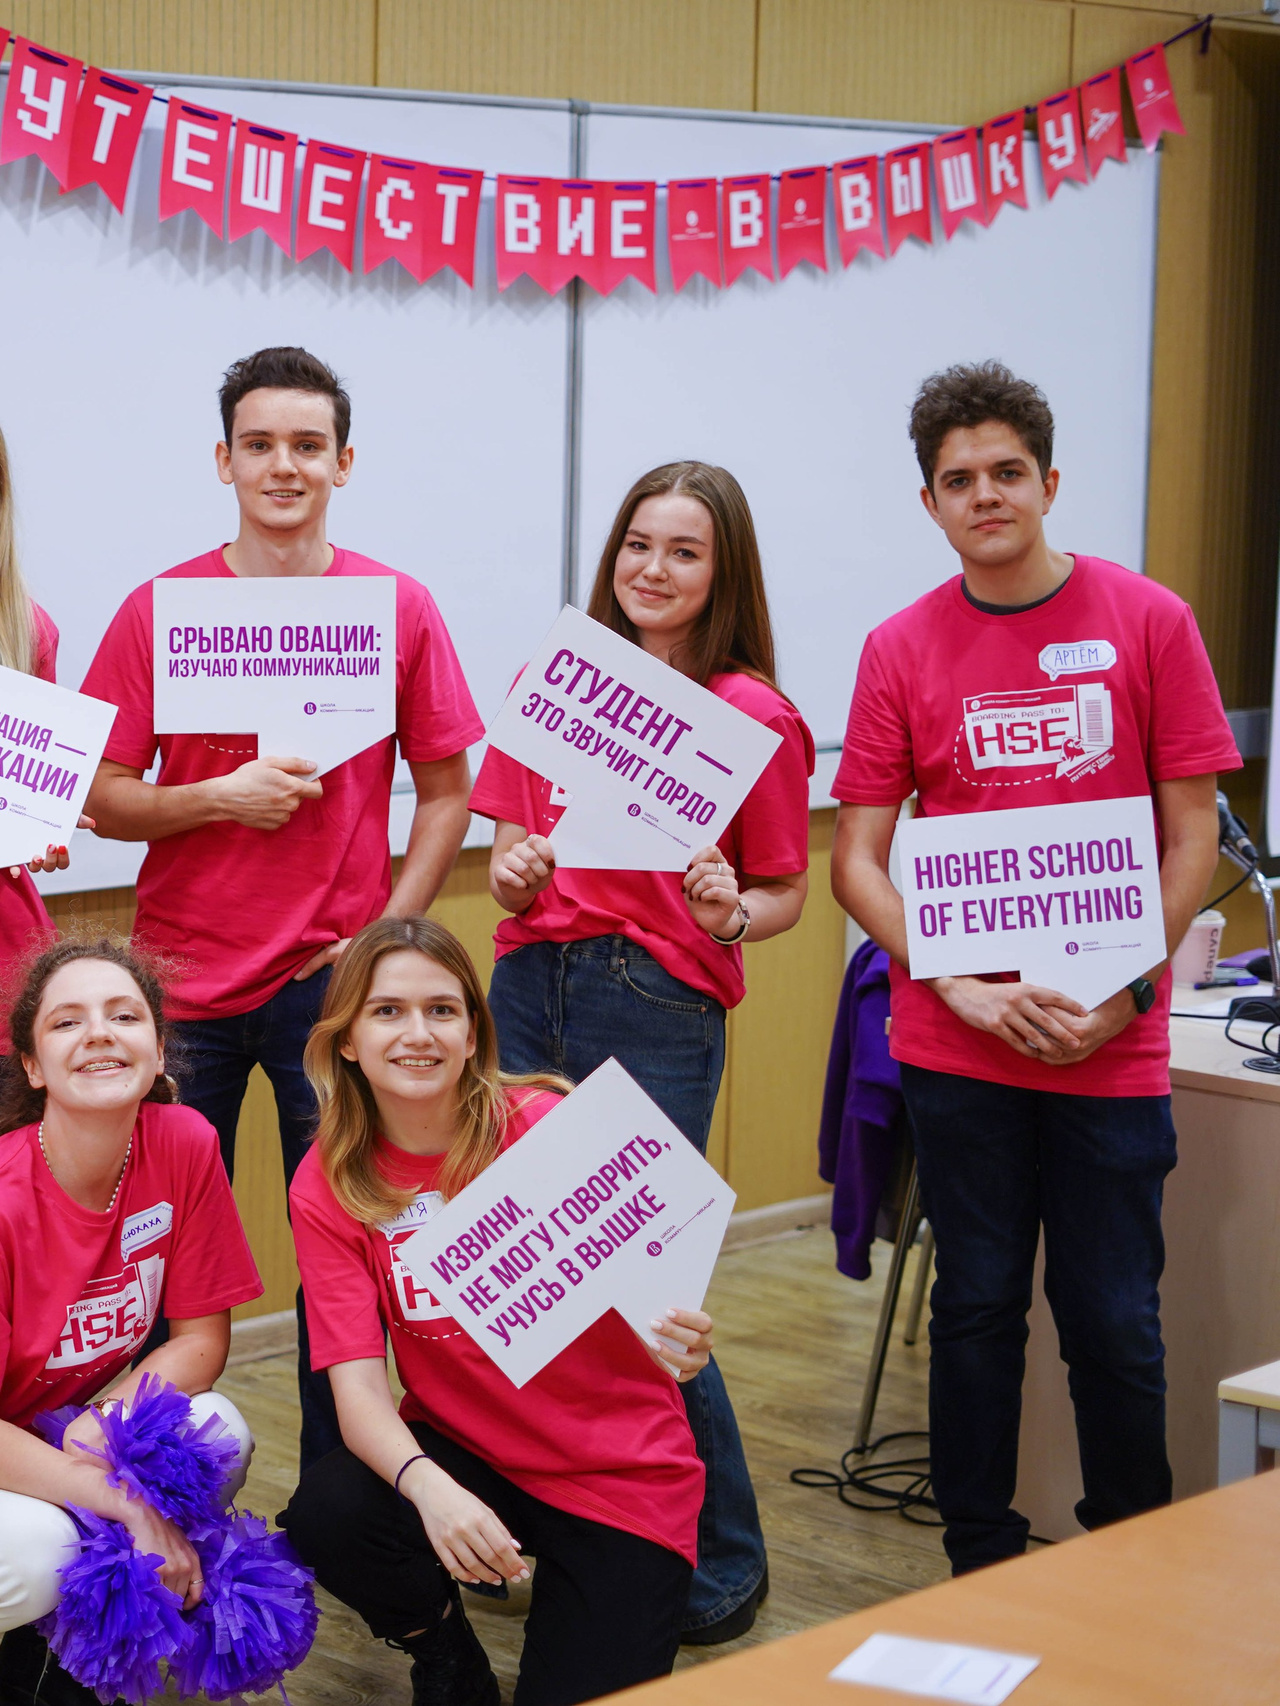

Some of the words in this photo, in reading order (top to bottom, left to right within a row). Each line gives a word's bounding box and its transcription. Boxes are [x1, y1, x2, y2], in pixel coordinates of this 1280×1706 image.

[730, 189, 762, 248] В
[841, 112, 1076, 232] ВЫШКУ
[169, 626, 272, 654] СРЫВАЮ
[280, 625, 381, 655] ОВАЦИИ:
[169, 658, 237, 678] ИЗУЧАЮ
[242, 657, 380, 678] КОММУНИКАЦИИ
[544, 649, 693, 756] СТУДЕНТ
[972, 712, 1016, 723] BOARDING
[1021, 710, 1045, 718] PASS
[1050, 707, 1065, 715] TO:
[521, 692, 565, 732] ЭТО
[562, 718, 650, 782] ЗВУЧИТ
[642, 767, 717, 826] ГОРДО
[973, 717, 1070, 758] HSE
[914, 848, 1021, 890] HIGHER
[1028, 837, 1143, 880] SCHOOL
[919, 902, 953, 938] OF
[962, 885, 1144, 934] EVERYTHING
[429, 1194, 534, 1285] ИЗВИНИ,
[458, 1274, 501, 1317] НЕ
[488, 1221, 555, 1290] МОГУ
[548, 1134, 672, 1237] ГОВОРИТЬ,
[485, 1277, 566, 1347] УЧУСЬ
[555, 1257, 584, 1287] В
[574, 1184, 666, 1272] ВЫШКЕ
[98, 1296, 122, 1309] PASS
